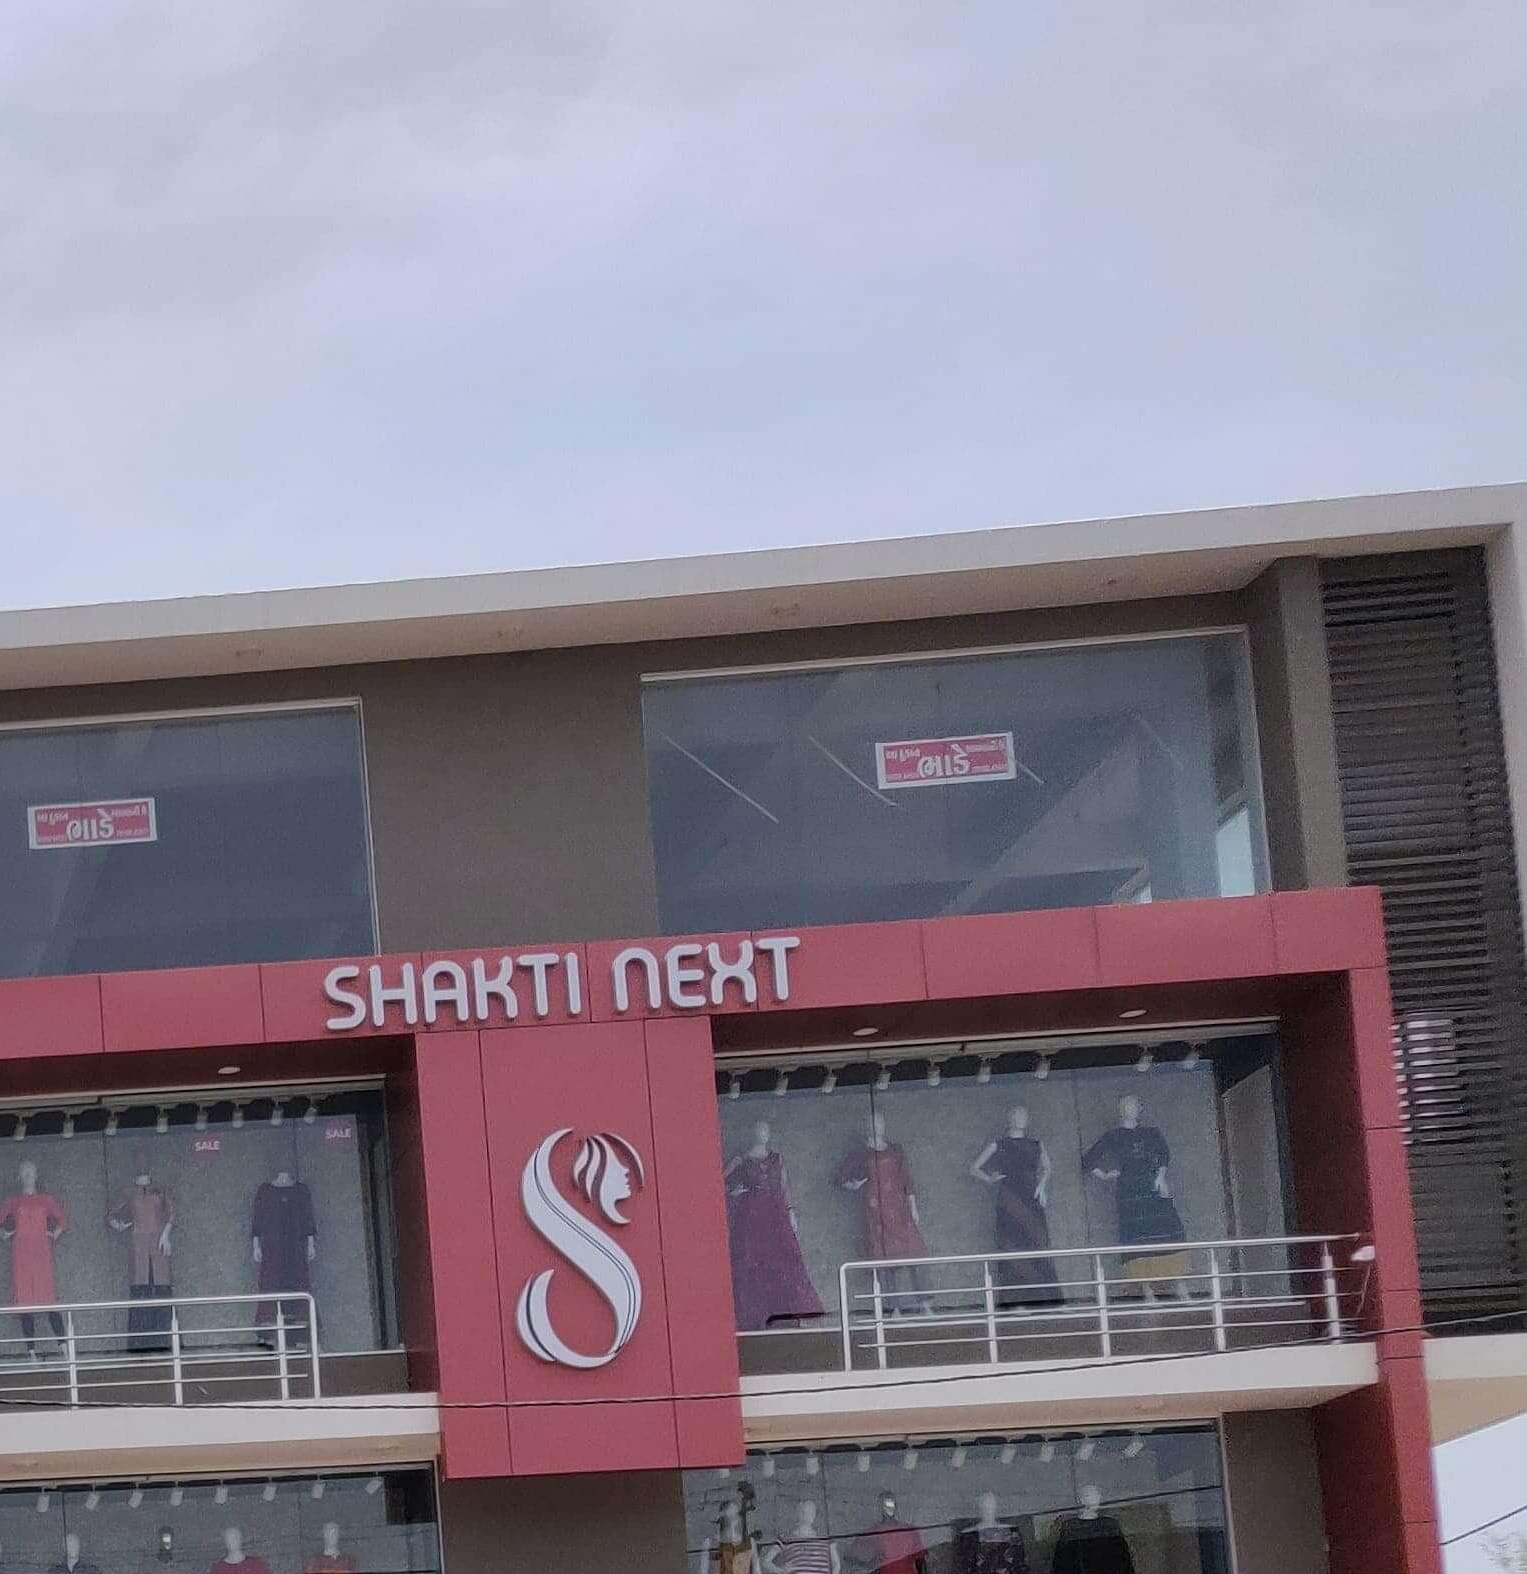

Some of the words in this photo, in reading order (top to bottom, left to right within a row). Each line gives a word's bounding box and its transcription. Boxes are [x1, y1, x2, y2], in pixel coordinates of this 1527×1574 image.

[917, 743, 971, 778] ભાડે
[66, 808, 115, 841] ભાડે
[325, 951, 582, 1032] SHAKTI
[609, 936, 802, 1016] NEXT
[194, 1140, 221, 1153] SALE
[326, 1127, 352, 1140] SALE
